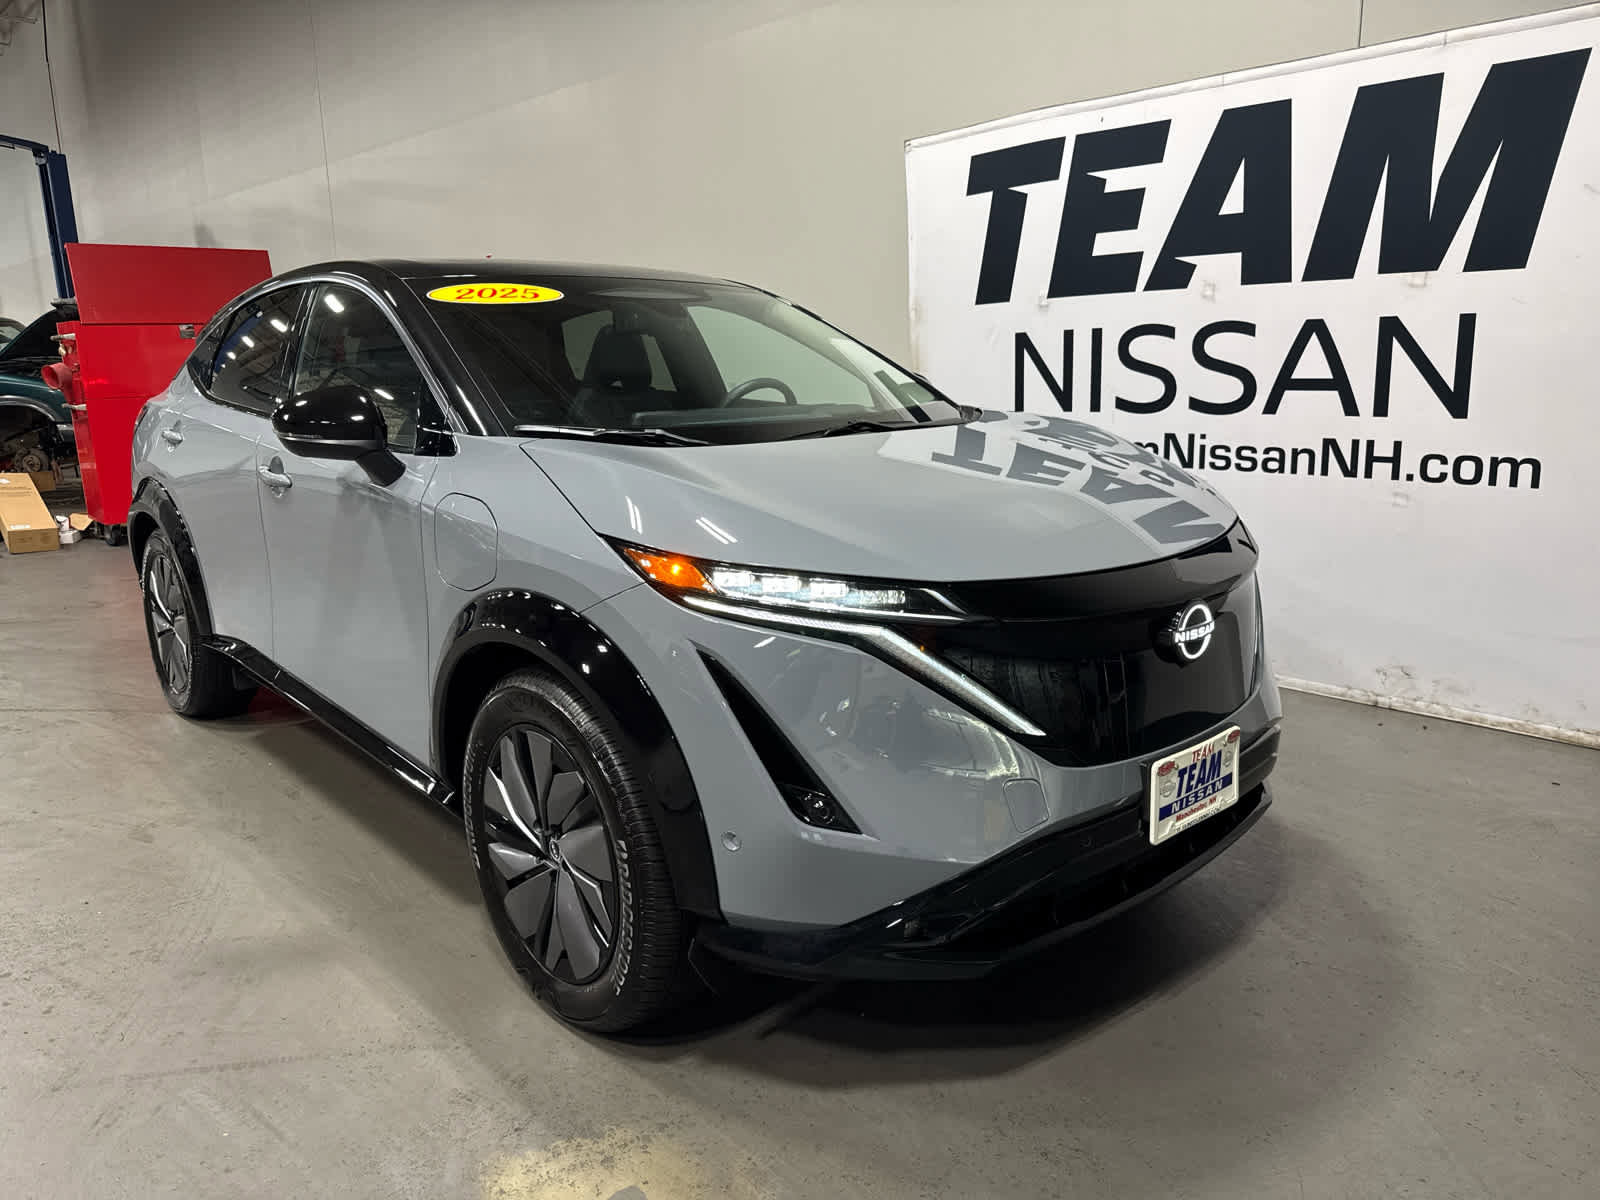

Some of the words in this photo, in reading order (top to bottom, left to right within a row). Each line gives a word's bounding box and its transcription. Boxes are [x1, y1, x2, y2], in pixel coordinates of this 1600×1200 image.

[967, 47, 1593, 305] TEAM
[456, 288, 540, 300] 2025
[1014, 312, 1478, 420] NISSAN
[1174, 620, 1215, 643] NISSAN
[1192, 744, 1215, 763] TEAM
[1176, 750, 1222, 798] TEAM
[1171, 778, 1223, 814] NISSAN
